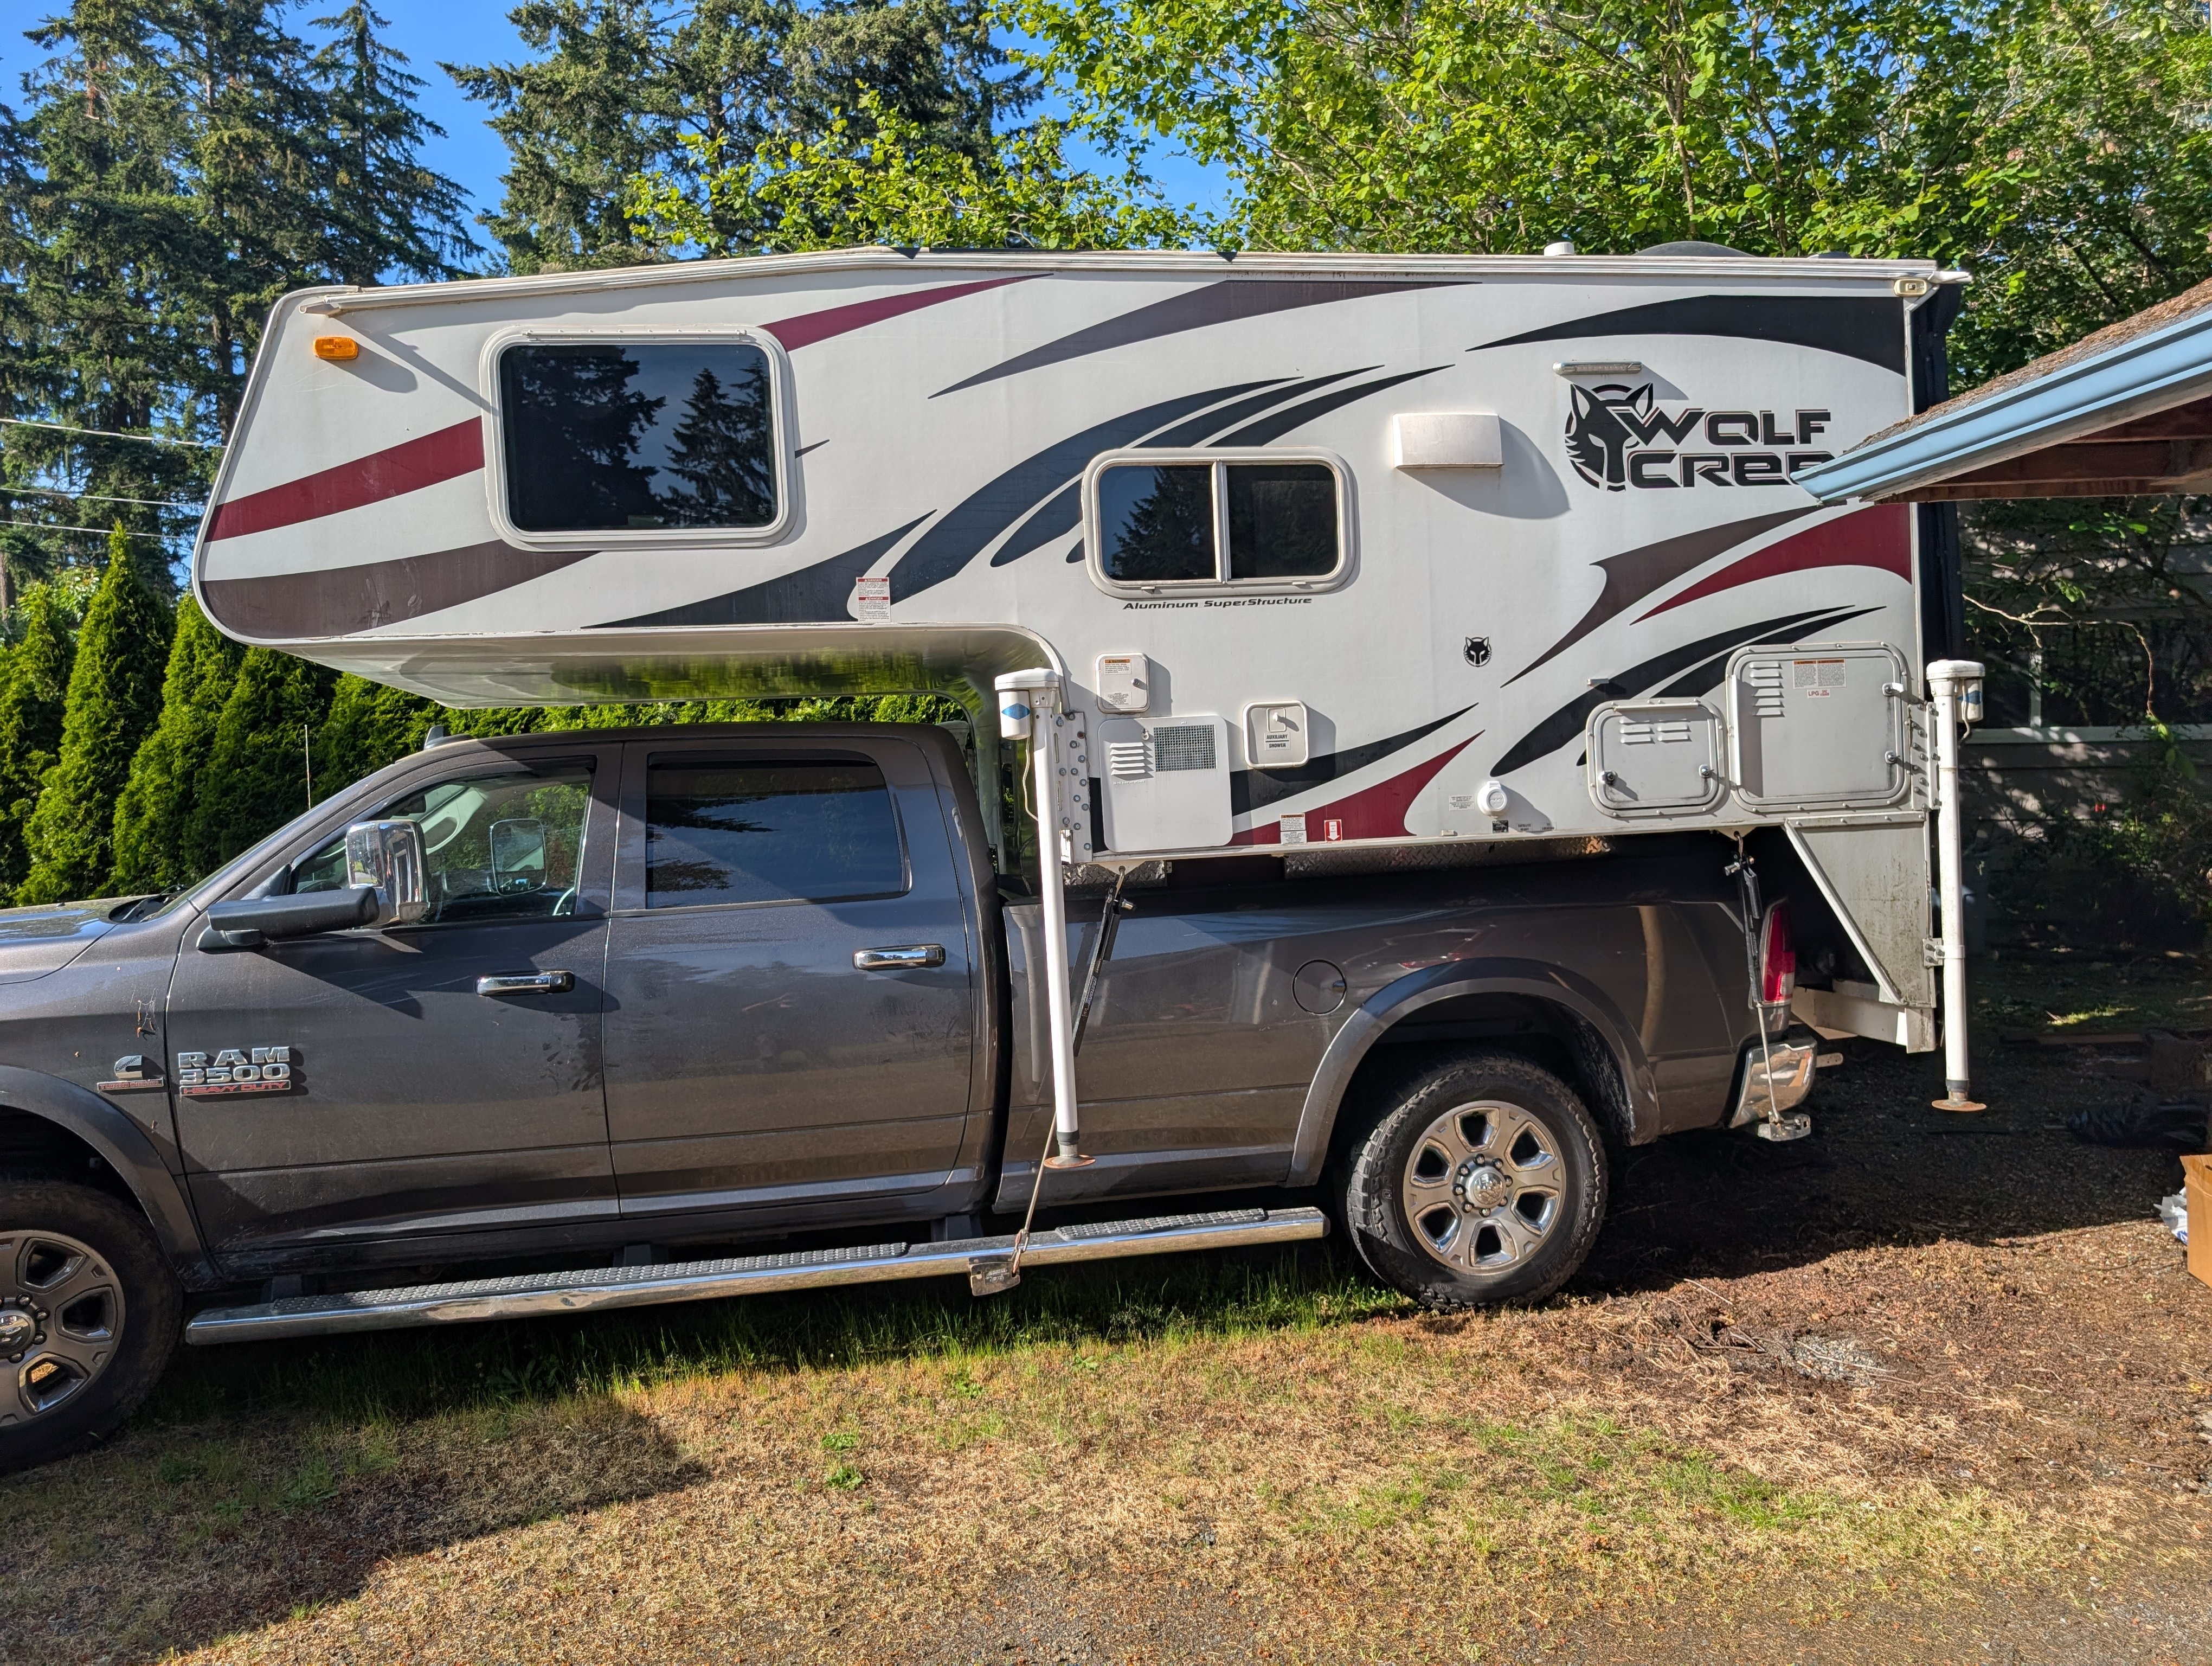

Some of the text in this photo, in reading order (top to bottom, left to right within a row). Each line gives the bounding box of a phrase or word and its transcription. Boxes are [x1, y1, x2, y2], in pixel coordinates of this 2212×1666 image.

[1612, 406, 1831, 446] WOLF
[1122, 597, 1312, 610] Aluminum SuperStructure
[115, 1055, 140, 1072] Cummins
[178, 1046, 290, 1068] RAM
[179, 1063, 290, 1085] 3500
[183, 1082, 287, 1094] HEAVY DUTY
